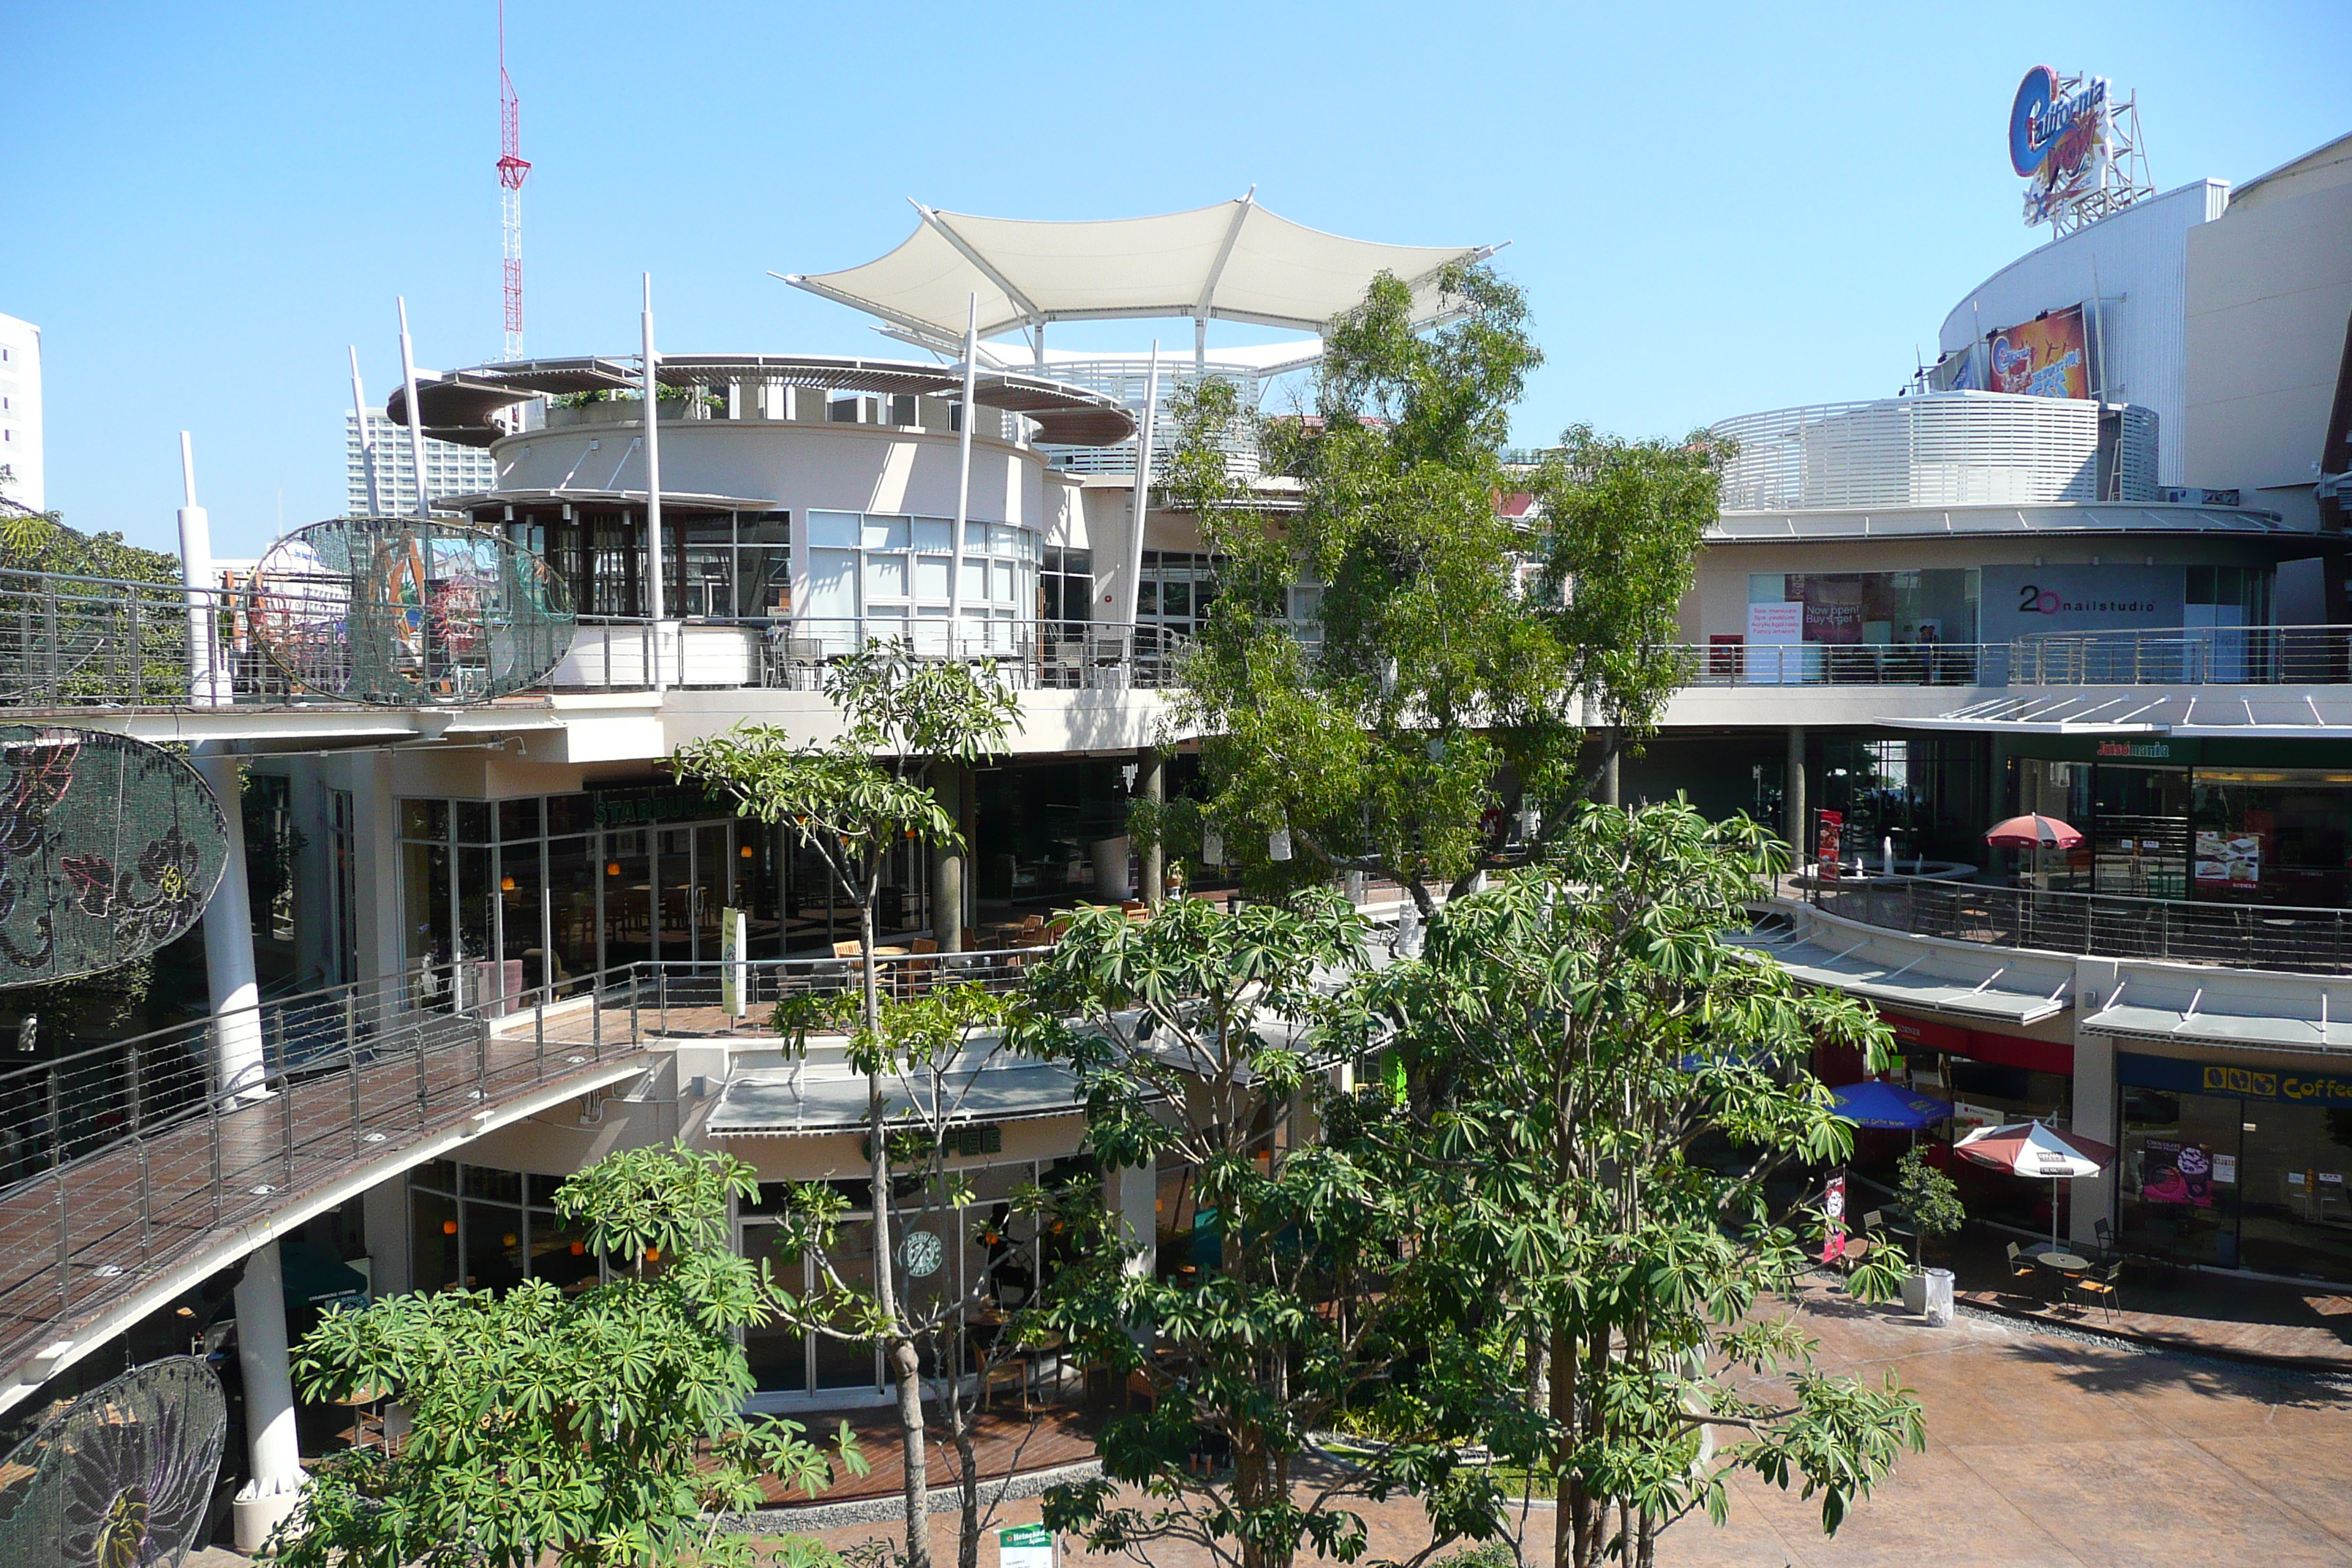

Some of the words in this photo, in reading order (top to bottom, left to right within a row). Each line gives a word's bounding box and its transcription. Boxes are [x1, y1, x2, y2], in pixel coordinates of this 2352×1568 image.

[2009, 64, 2106, 178] California
[2063, 600, 2154, 611] nailstudio
[1807, 606, 1828, 615] Now
[1831, 606, 1859, 616] open!
[1806, 615, 1825, 625] Buy
[1837, 615, 1852, 625] get
